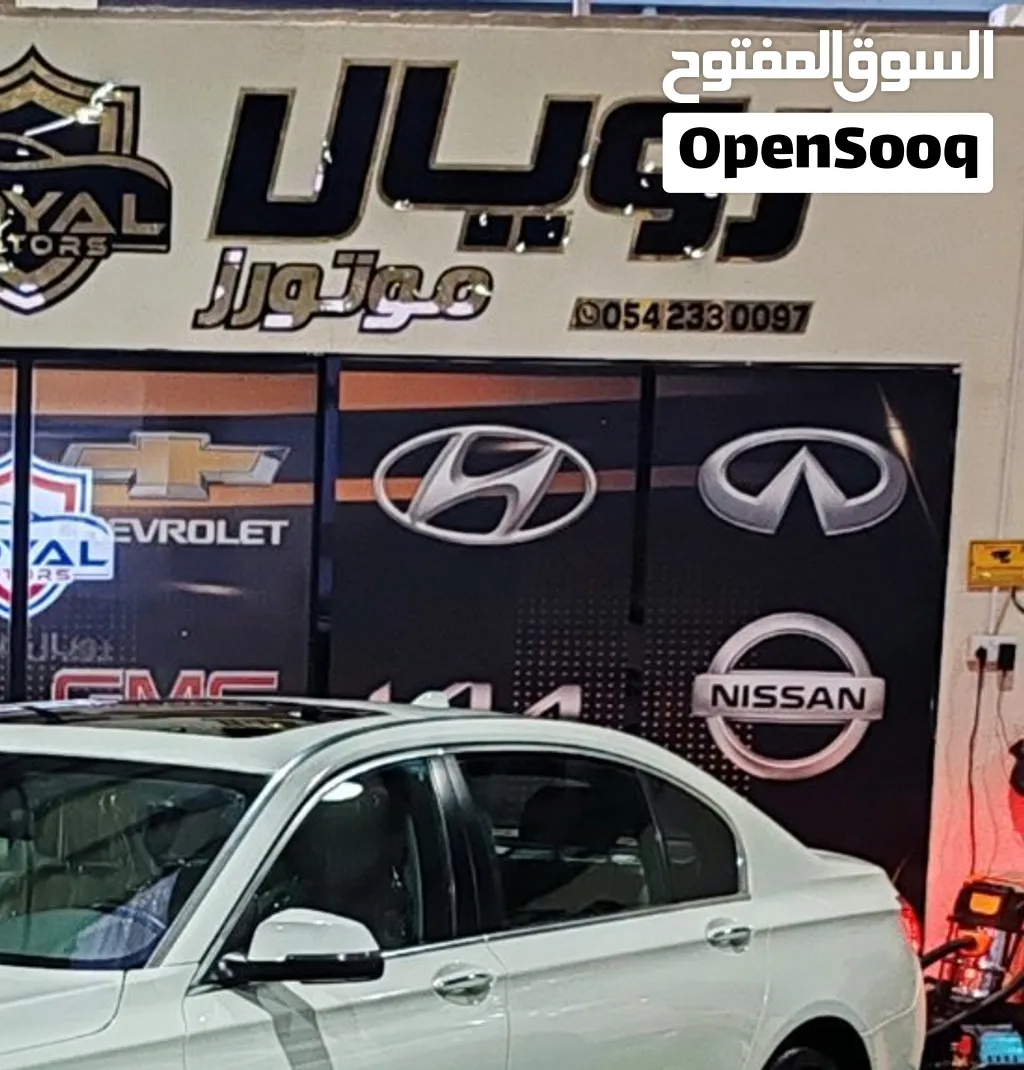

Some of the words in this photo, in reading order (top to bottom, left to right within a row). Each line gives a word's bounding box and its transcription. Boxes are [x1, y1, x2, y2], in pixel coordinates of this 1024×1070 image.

[191, 247, 493, 332] موتورز
[602, 301, 661, 330] 054
[666, 303, 724, 331] 233
[731, 304, 814, 333] 0097
[109, 517, 289, 545] EVROLET
[711, 683, 866, 711] NISSAN
